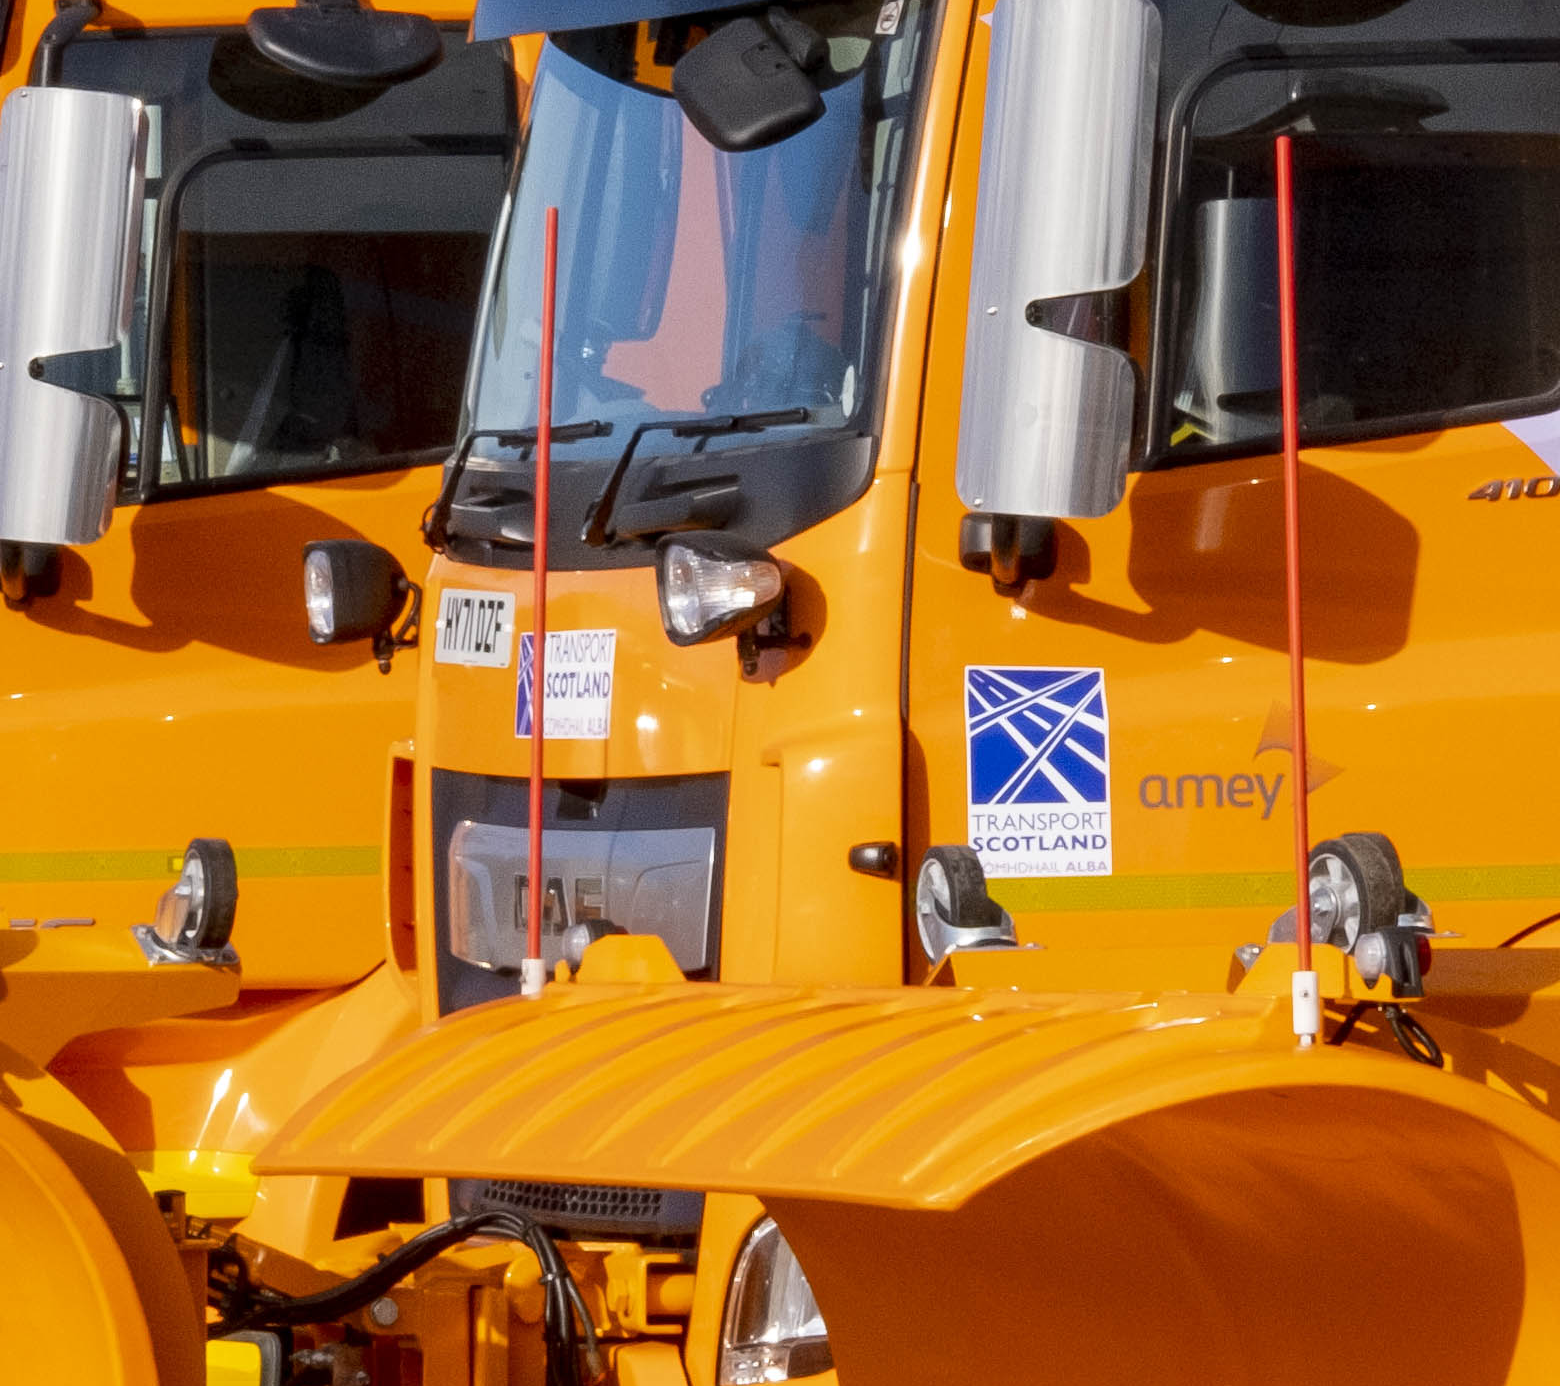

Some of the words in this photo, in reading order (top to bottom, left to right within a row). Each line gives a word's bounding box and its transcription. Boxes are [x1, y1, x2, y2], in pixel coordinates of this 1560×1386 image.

[443, 596, 475, 651] HY71
[475, 599, 505, 653] DZF
[549, 632, 615, 664] TRANSPORT
[545, 672, 611, 699] SCOTLAND
[1139, 773, 1285, 820] amey
[972, 811, 1107, 833] TRANSPORT
[971, 834, 1107, 853] SCOTLAND
[1066, 860, 1108, 873] ALBA
